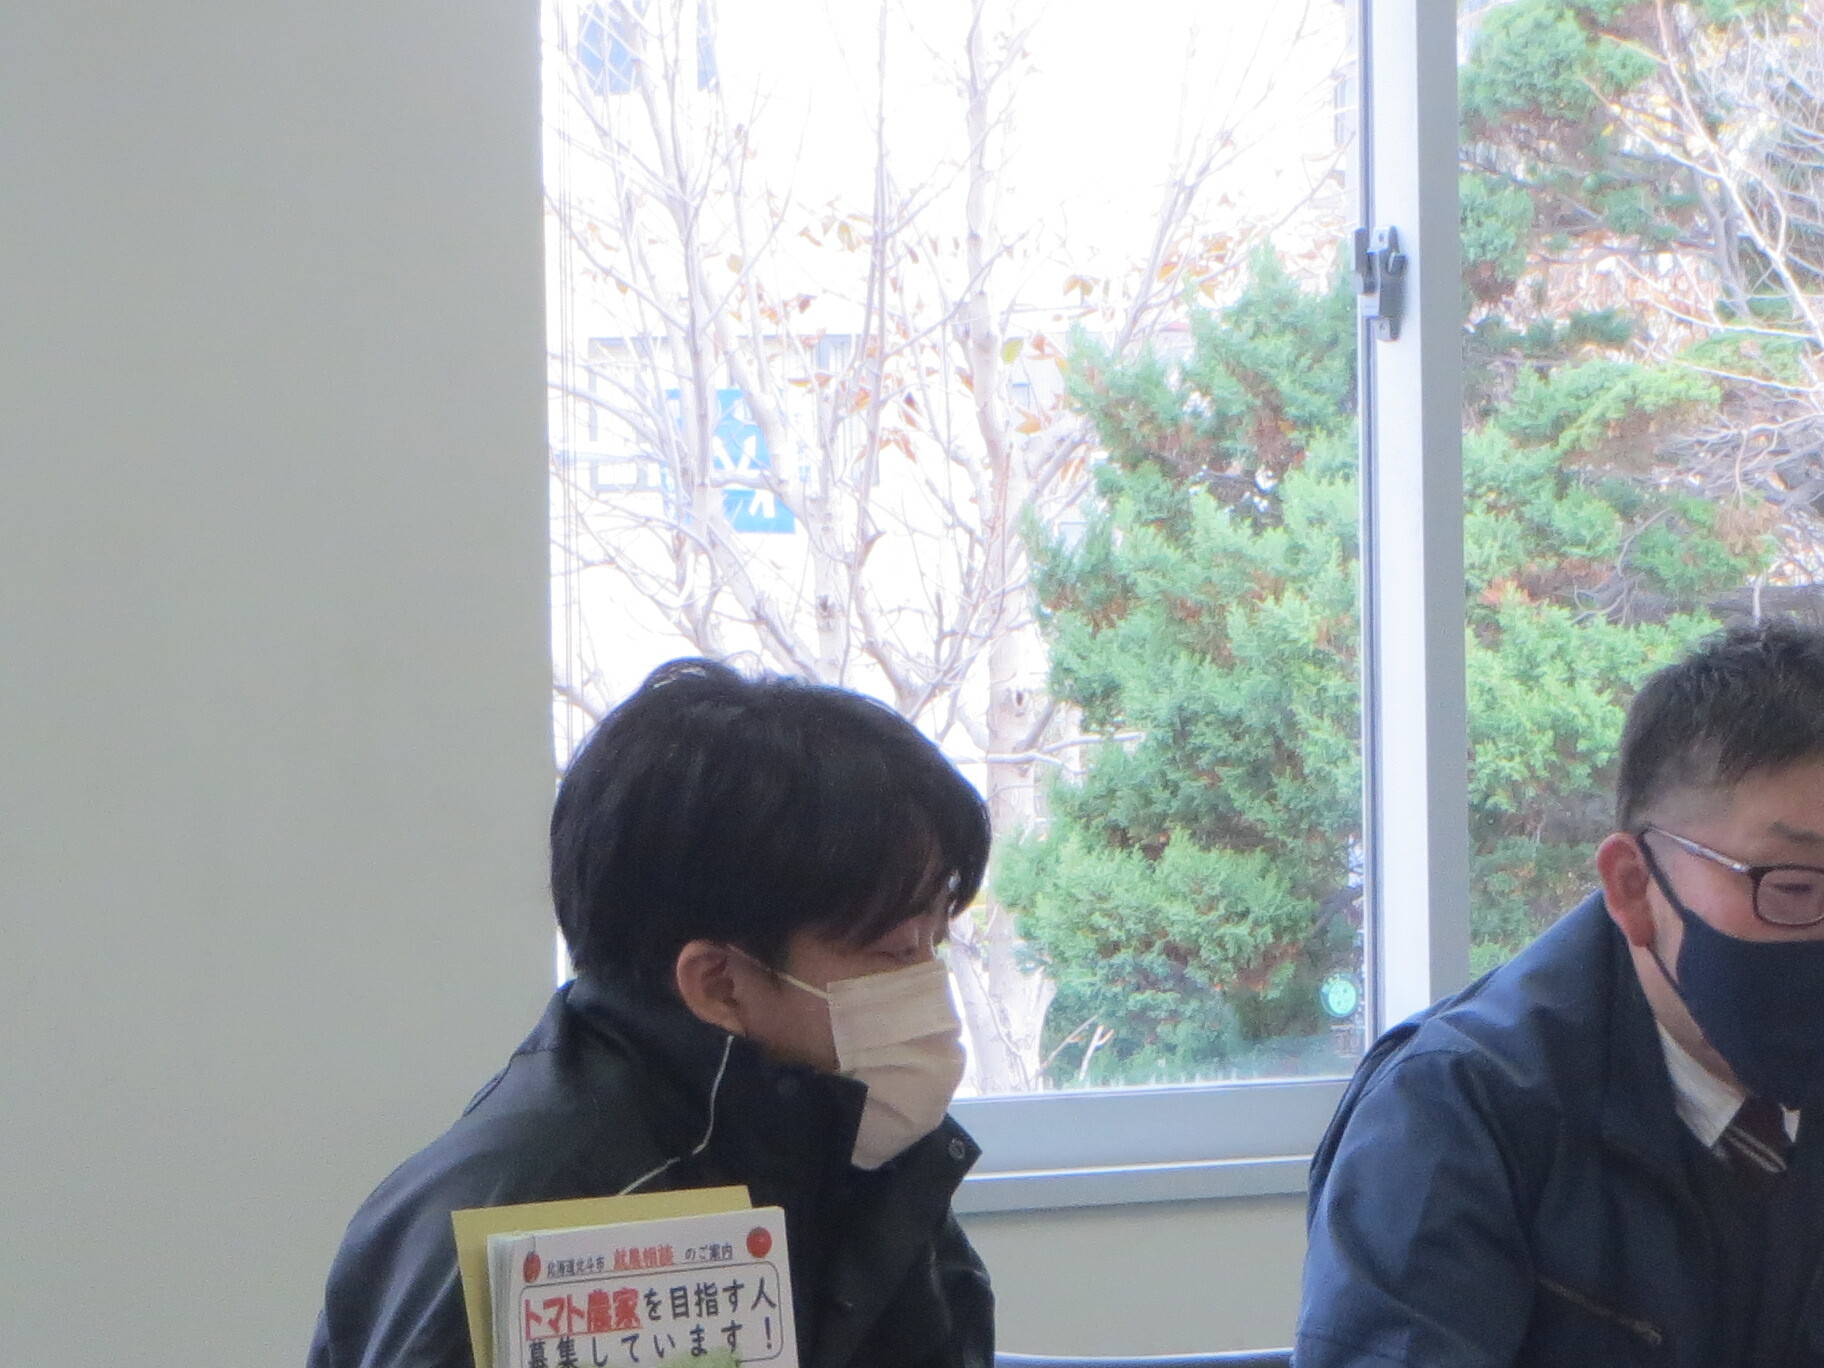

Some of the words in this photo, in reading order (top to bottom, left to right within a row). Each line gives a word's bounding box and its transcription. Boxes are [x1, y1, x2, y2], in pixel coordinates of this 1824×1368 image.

[524, 1275, 777, 1339] トマト農家を目指す人
